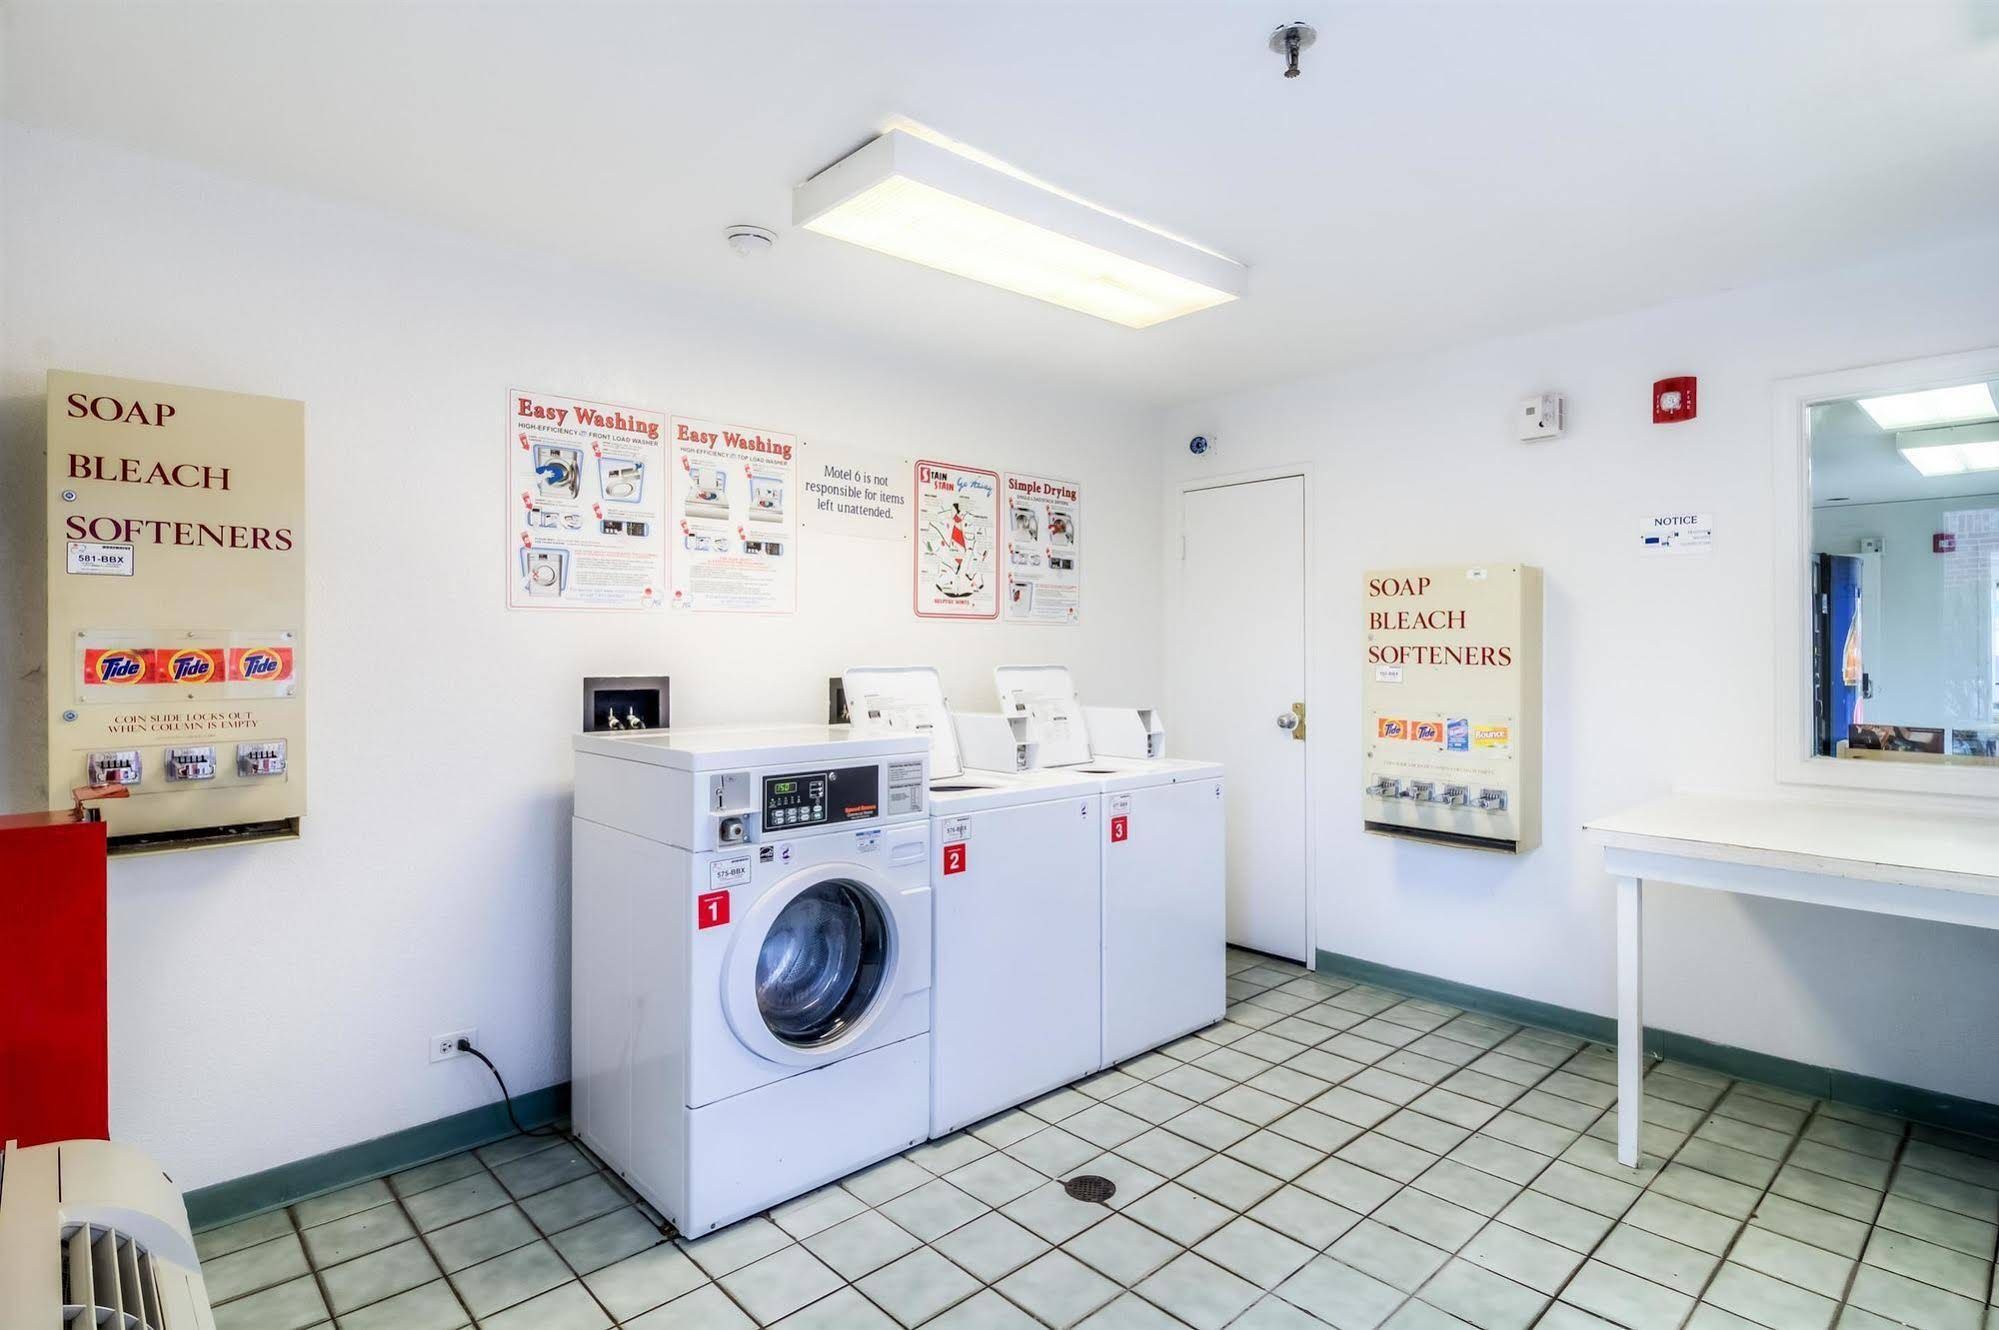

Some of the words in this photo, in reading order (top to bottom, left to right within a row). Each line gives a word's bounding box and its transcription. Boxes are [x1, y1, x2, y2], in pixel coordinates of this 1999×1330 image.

[67, 392, 176, 427] SOAP
[517, 397, 568, 427] Easy
[573, 406, 660, 440] Washing
[517, 422, 578, 436] HIGH-EFFICIENCY
[588, 432, 611, 441] FRONT
[612, 436, 631, 444] LOAD
[631, 438, 659, 447] WASHER
[677, 423, 718, 450] Easy
[722, 431, 793, 461] Washing
[67, 453, 231, 491] BLEACH
[824, 465, 852, 481] Motel
[854, 470, 861, 482] 6
[863, 472, 871, 484] is
[874, 476, 889, 487] not
[805, 481, 862, 499] responsible
[864, 489, 877, 501] for
[880, 490, 905, 505] items
[934, 480, 954, 492] STAIN
[1008, 477, 1042, 495] Simple
[1043, 483, 1077, 502] Drying
[817, 498, 834, 511] left
[837, 503, 894, 520] unattended.
[1654, 515, 1698, 527] NOTICE
[66, 515, 293, 551] SOFTENERS
[78, 554, 124, 564] 581-BBX
[1369, 577, 1431, 598] SOAP
[1369, 610, 1466, 631] BLEACH
[245, 654, 277, 678] Tide
[1368, 645, 1512, 667] SOFTENERS
[102, 656, 140, 680] Tide
[174, 656, 210, 680] Tide
[107, 723, 147, 733] WHEN
[151, 722, 203, 732] COLUMN
[207, 721, 217, 730] IS
[221, 720, 258, 729] EMPTY
[114, 714, 146, 724] COIN
[150, 713, 181, 723] SLIDE
[186, 712, 225, 721] LOCKS
[228, 711, 253, 720] OUT
[1384, 723, 1401, 736] Tide
[1418, 726, 1435, 739] Tide
[1115, 823, 1123, 838] 3
[950, 852, 960, 870] 2
[708, 901, 718, 921] 1
